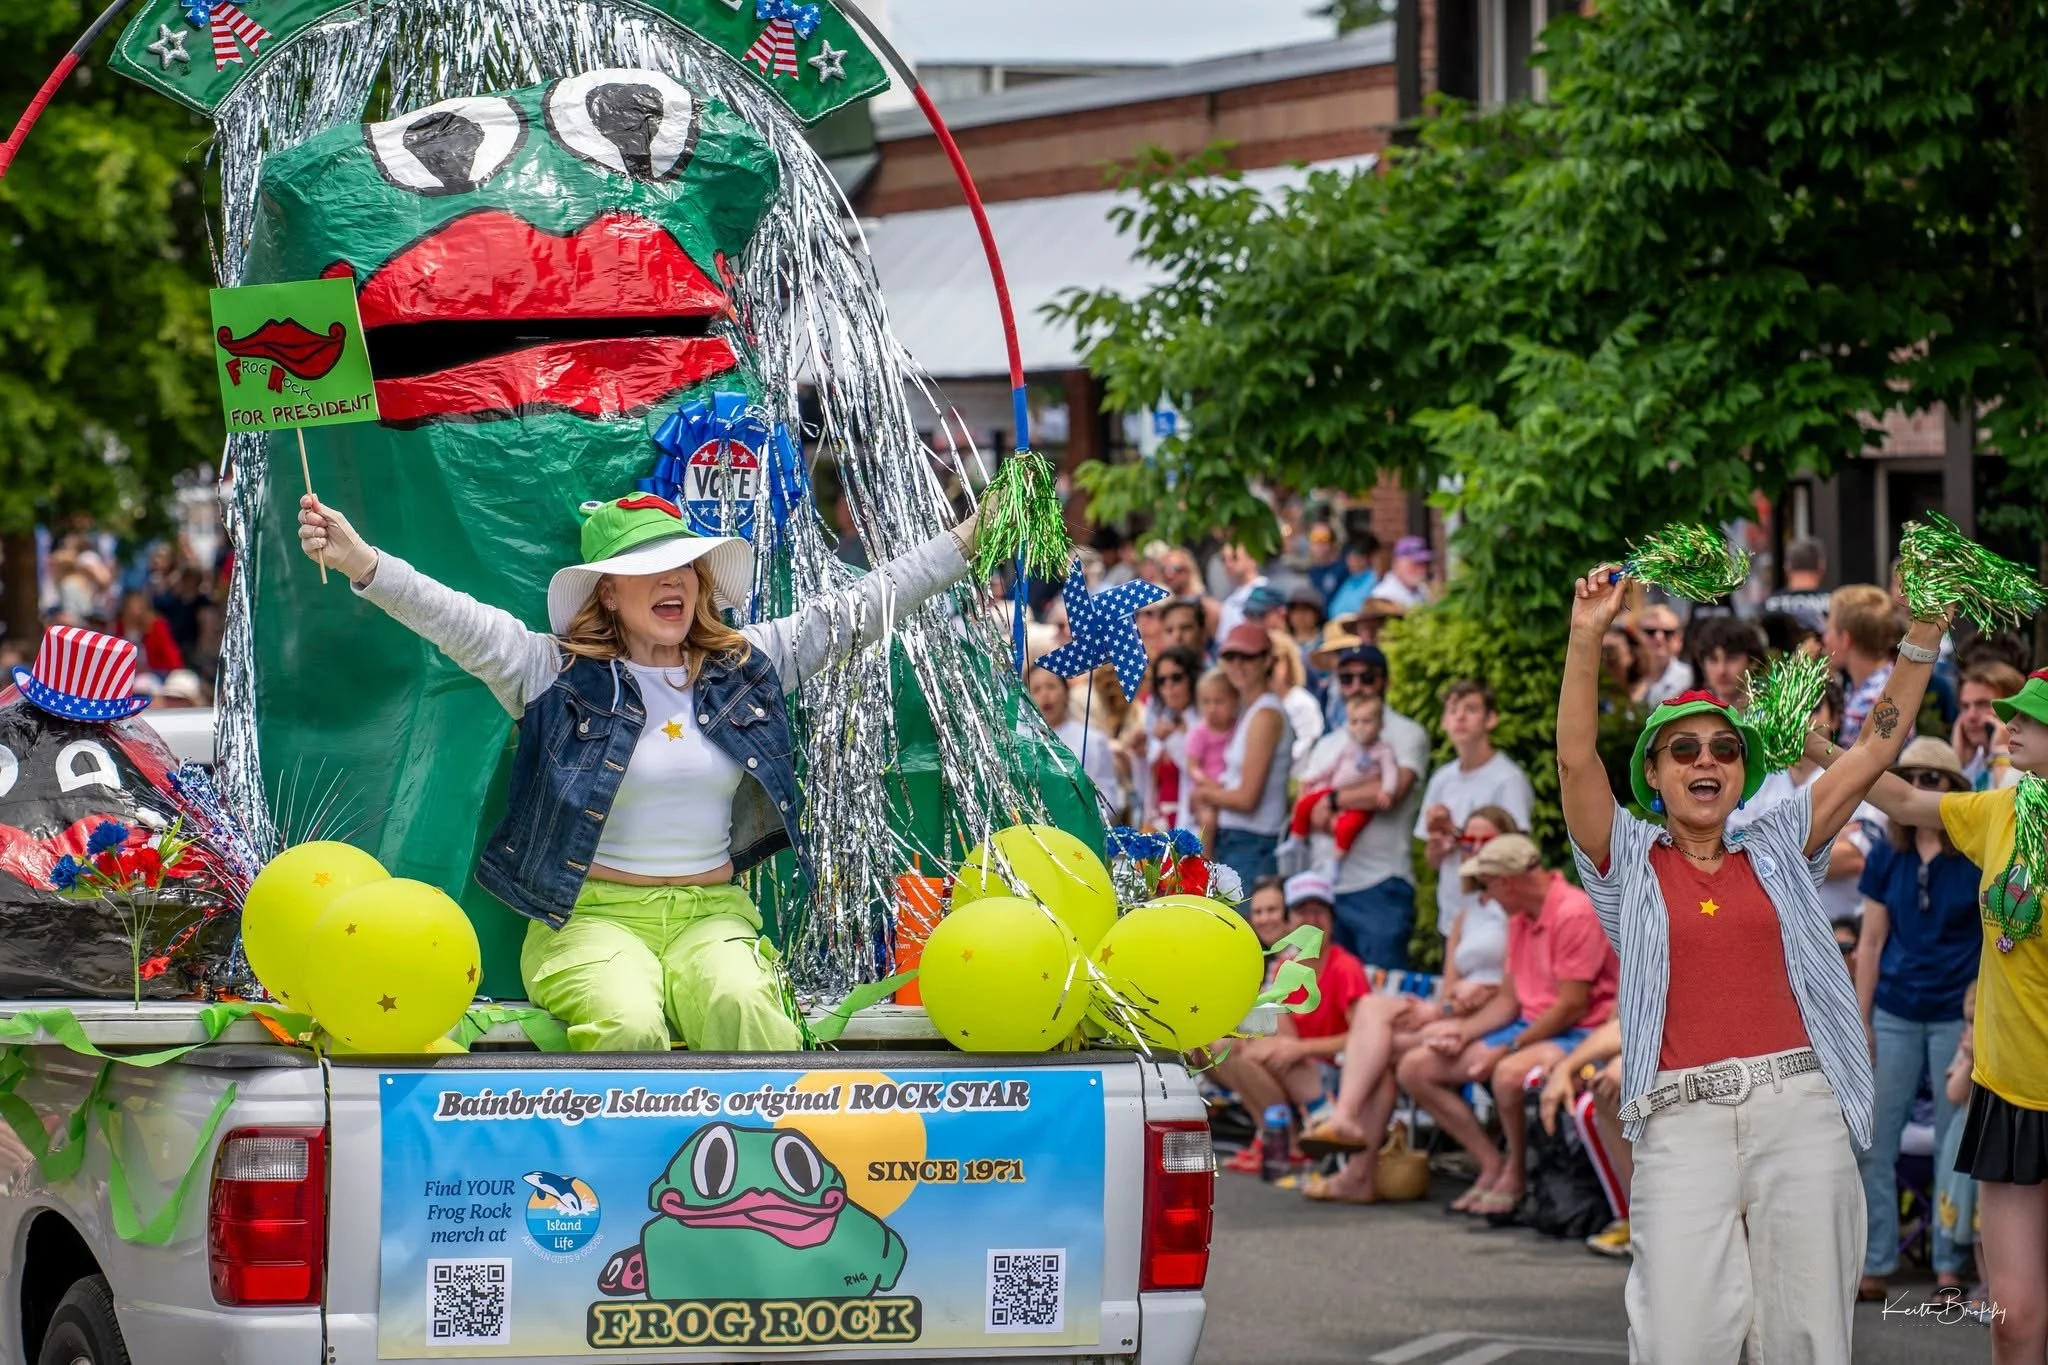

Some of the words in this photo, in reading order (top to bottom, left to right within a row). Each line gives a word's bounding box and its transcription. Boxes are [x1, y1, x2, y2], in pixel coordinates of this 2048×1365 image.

[225, 357, 268, 387] FROG
[267, 364, 313, 401] ROCK
[230, 408, 266, 427] FOR
[272, 393, 372, 423] PRESIDENT
[437, 1088, 602, 1122] Bainbridge
[606, 1087, 721, 1113] Island's
[727, 1085, 842, 1118] original
[849, 1083, 944, 1110] ROCK
[946, 1081, 1030, 1108] STAR
[867, 1160, 959, 1182] SINCE
[963, 1159, 1025, 1182] 1971
[423, 1179, 462, 1197] Find
[466, 1179, 516, 1196] YOUR
[427, 1204, 467, 1224] Frog
[469, 1202, 512, 1219] Rock
[430, 1226, 485, 1243] merch
[488, 1227, 507, 1242] at
[546, 1218, 582, 1231] Island
[554, 1236, 574, 1251] Life
[594, 1303, 754, 1344] FROG
[762, 1301, 915, 1342] ROCK
